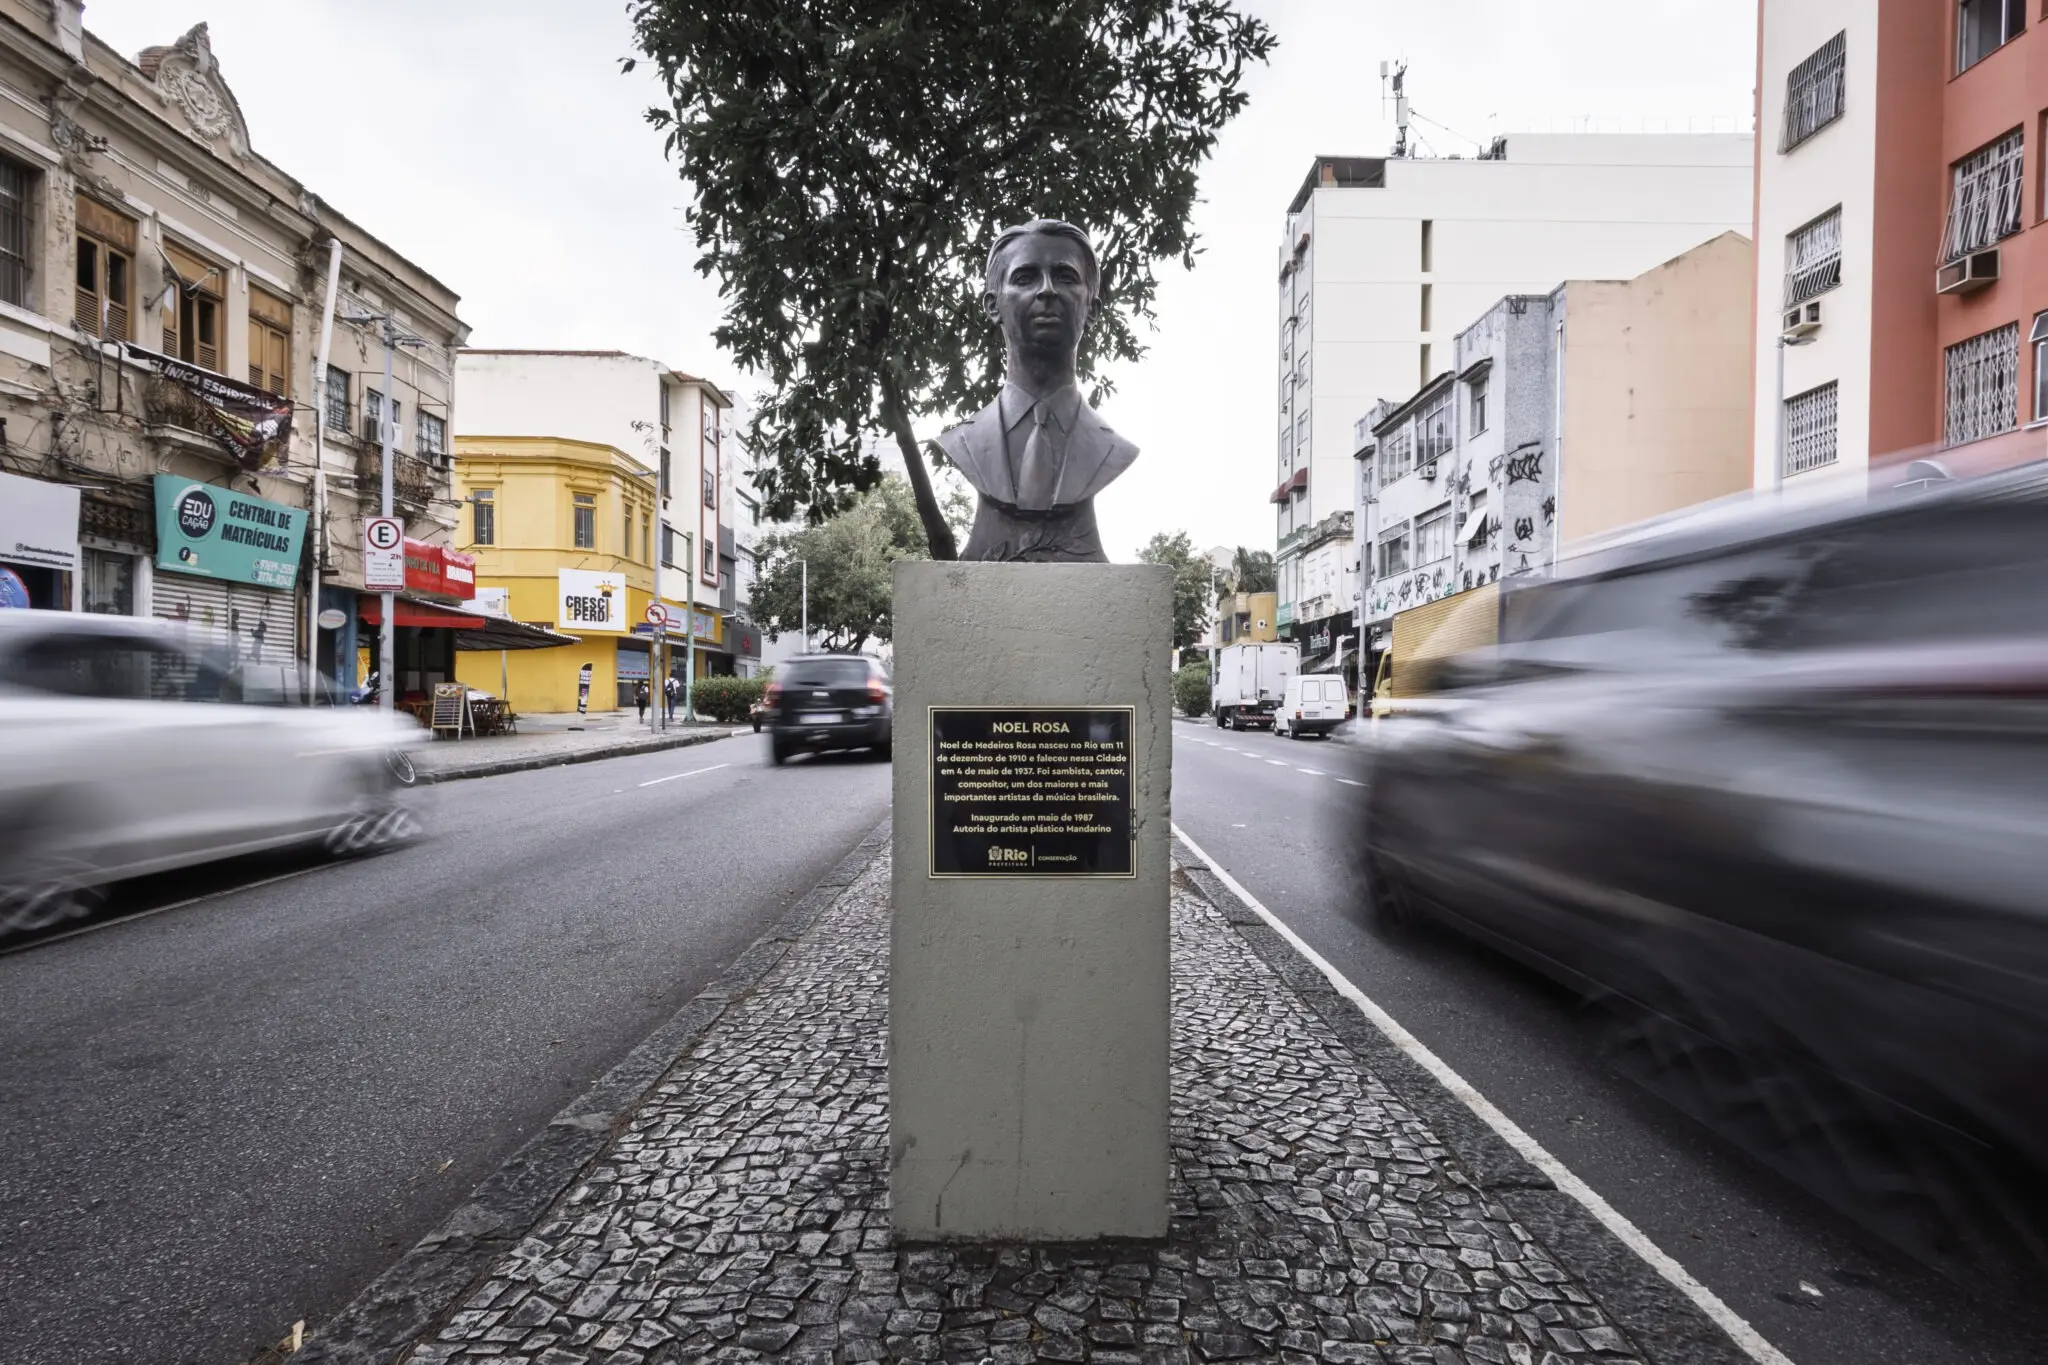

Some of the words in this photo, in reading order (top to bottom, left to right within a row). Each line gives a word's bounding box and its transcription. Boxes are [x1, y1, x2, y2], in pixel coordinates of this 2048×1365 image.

[183, 498, 213, 519] EDU
[229, 500, 276, 529] CENTRAL
[277, 511, 292, 530] DE
[221, 524, 290, 553] MATRÍCULAS
[377, 526, 390, 543] E
[992, 721, 1030, 734] NOEL
[1032, 721, 1070, 734] ROSA
[940, 740, 960, 750] Noel
[961, 740, 973, 750] de
[975, 740, 1014, 750] Medeiros
[1016, 741, 1037, 750] Rosa
[1038, 742, 1069, 750] nasceu
[1070, 742, 1082, 750] no
[1084, 740, 1098, 750] Rio
[1100, 742, 1114, 750] em
[1116, 741, 1124, 750] 11
[936, 753, 948, 763] de
[949, 753, 994, 763] dezembro
[995, 753, 1007, 763] de
[1008, 754, 1027, 763] 1910
[1028, 755, 1035, 763] e
[1036, 753, 1068, 763] faleceu
[1070, 755, 1094, 763] nessa
[1096, 753, 1127, 763] Cidade
[940, 766, 955, 776] em
[956, 766, 963, 776] 4
[964, 766, 976, 776] de
[978, 766, 1000, 776] maio
[1001, 766, 1013, 776] de
[1014, 767, 1035, 776] 1937.
[1037, 766, 1050, 776] Foi
[1052, 766, 1093, 777] sambista,
[1095, 767, 1125, 777] cantor,
[957, 780, 1010, 790] compositor,
[1011, 781, 1025, 789] um
[1026, 779, 1043, 789] dos
[1044, 779, 1079, 789] maiores
[1080, 781, 1087, 789] e
[1088, 779, 1109, 789] mais
[944, 792, 997, 803] importantes
[998, 792, 1031, 802] artistas
[1032, 792, 1044, 802] da
[1045, 792, 1076, 802] música
[1077, 792, 1120, 802] brasileira.
[971, 812, 1020, 823] Inaugurado
[1021, 814, 1036, 822] em
[1037, 812, 1059, 822] maio
[1060, 813, 1073, 822] de
[1074, 813, 1094, 822] 1987
[953, 824, 985, 833] Autoria
[986, 824, 999, 833] do
[1000, 824, 1028, 833] artista
[1030, 824, 1065, 835] plástico
[1066, 824, 1112, 833] Mandarino
[1003, 848, 1028, 861] Rio
[1038, 854, 1078, 862] CONSERVAÇÃO
